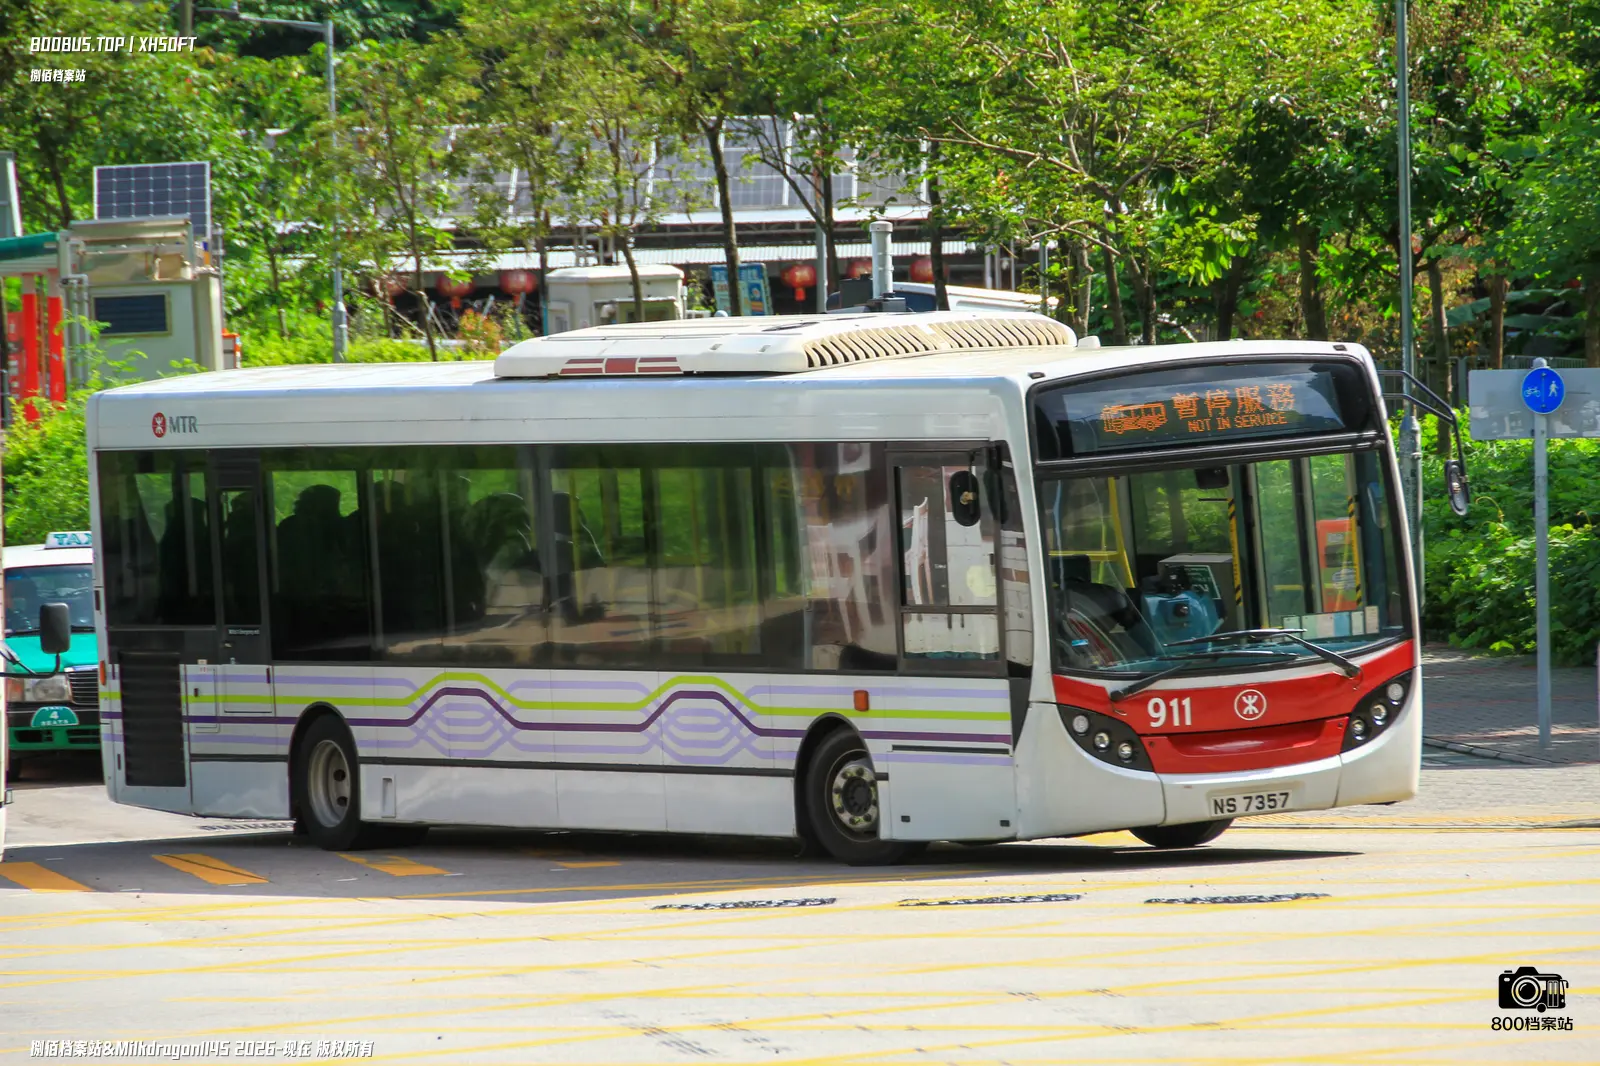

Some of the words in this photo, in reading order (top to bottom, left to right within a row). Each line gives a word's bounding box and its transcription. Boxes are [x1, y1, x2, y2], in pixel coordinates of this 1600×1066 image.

[1171, 383, 1295, 420] 暫停服務
[168, 415, 199, 434] MTR
[1188, 418, 1211, 433] NOT
[1217, 416, 1232, 431] IN
[1235, 411, 1288, 429] SERVICE
[49, 710, 60, 720] 4
[1147, 696, 1193, 728] 911
[1213, 797, 1237, 815] NS
[1243, 791, 1290, 812] 7357
